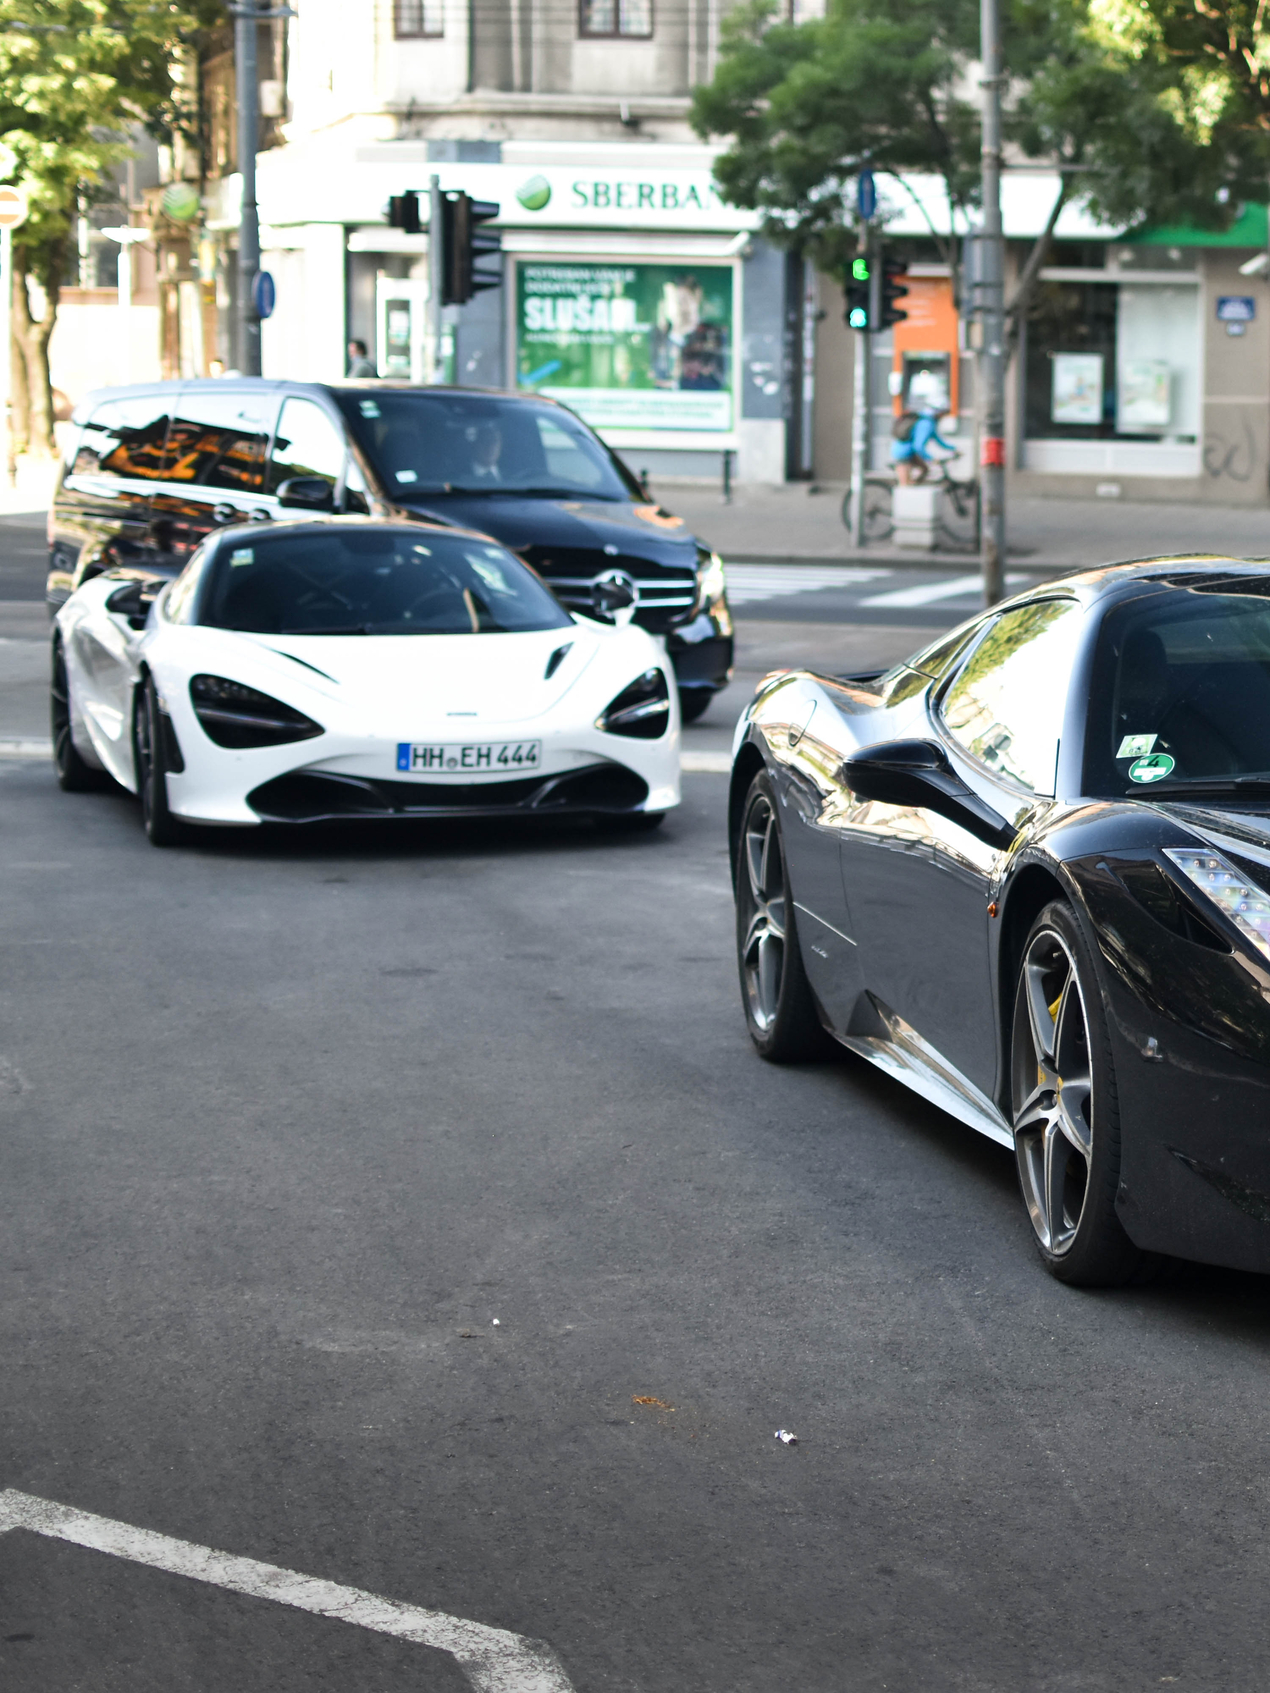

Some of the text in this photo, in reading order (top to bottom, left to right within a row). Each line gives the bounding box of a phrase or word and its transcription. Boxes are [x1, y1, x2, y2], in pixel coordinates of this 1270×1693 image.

[412, 743, 537, 768] HH EH 444
[1146, 755, 1160, 768] 4
